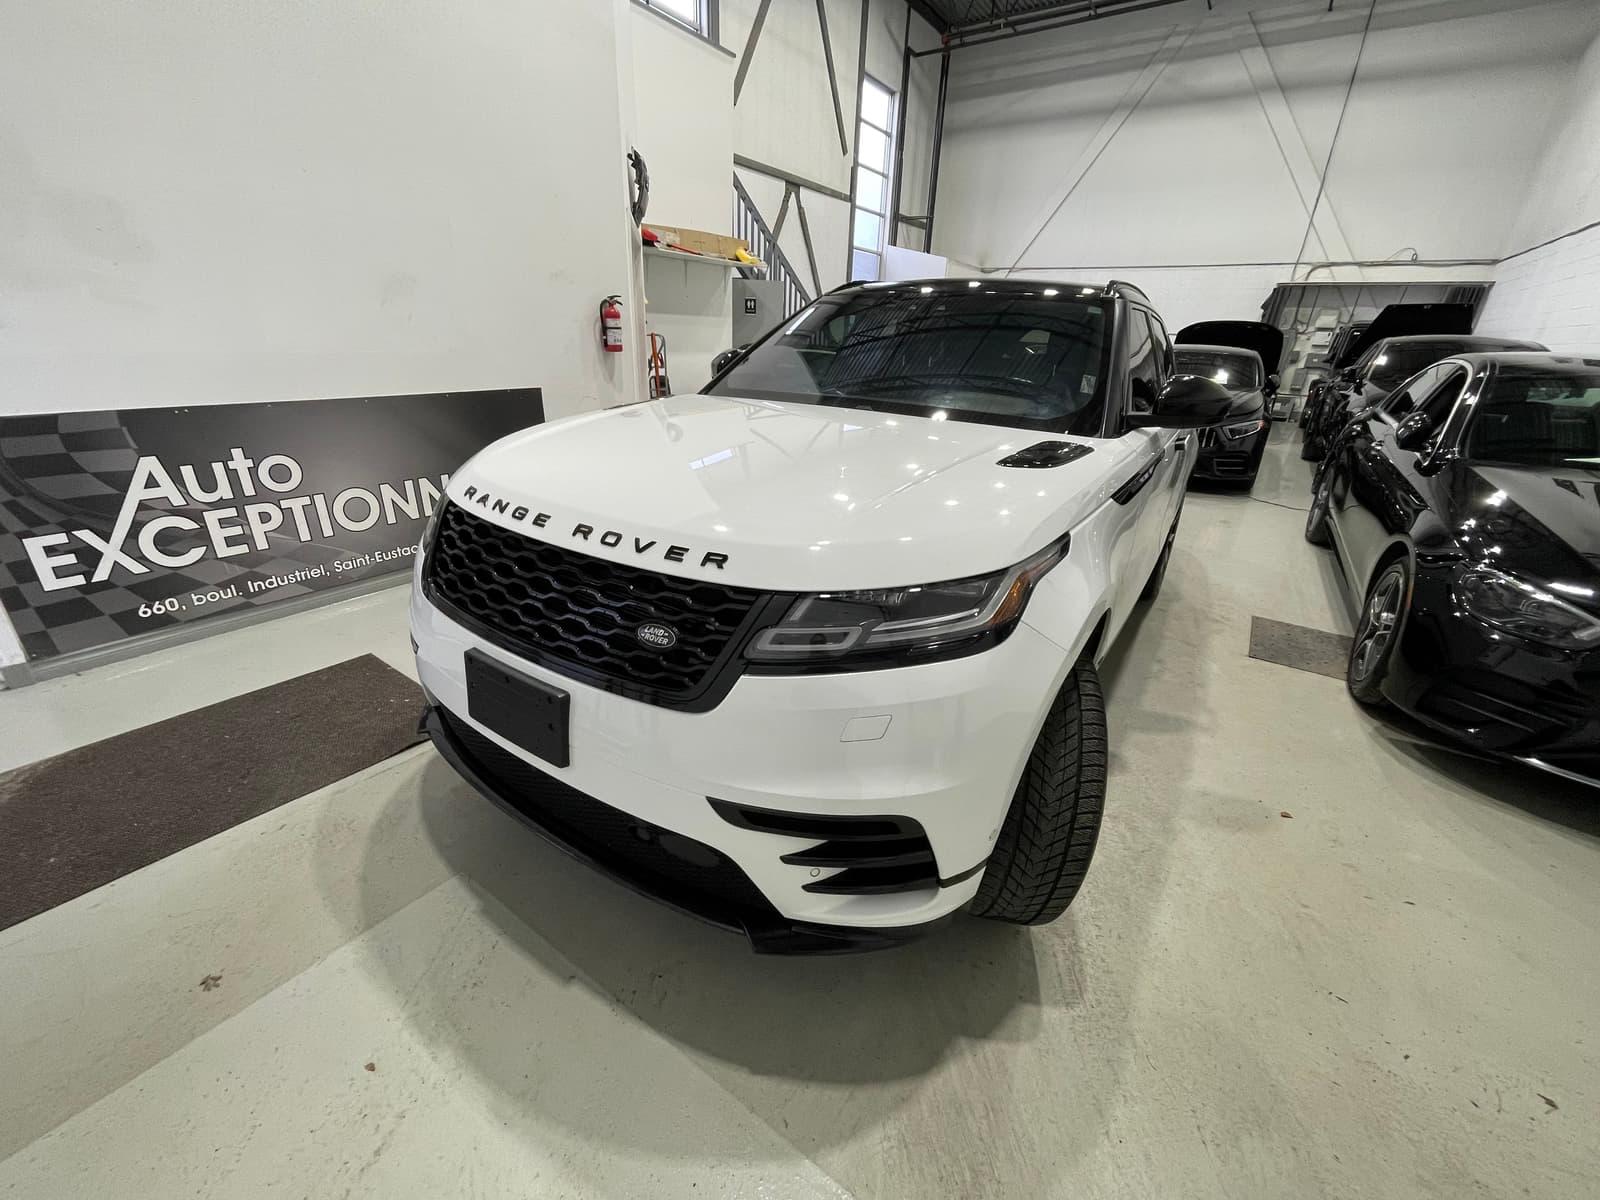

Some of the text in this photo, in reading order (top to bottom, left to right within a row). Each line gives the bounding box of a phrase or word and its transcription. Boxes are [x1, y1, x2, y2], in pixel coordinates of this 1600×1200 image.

[122, 447, 303, 508] Auto
[464, 485, 729, 570] RANGE ROVER
[138, 597, 187, 618] 660,
[191, 584, 243, 607] boul.
[249, 564, 330, 593] Industriel,
[643, 632, 669, 645] ROVER
